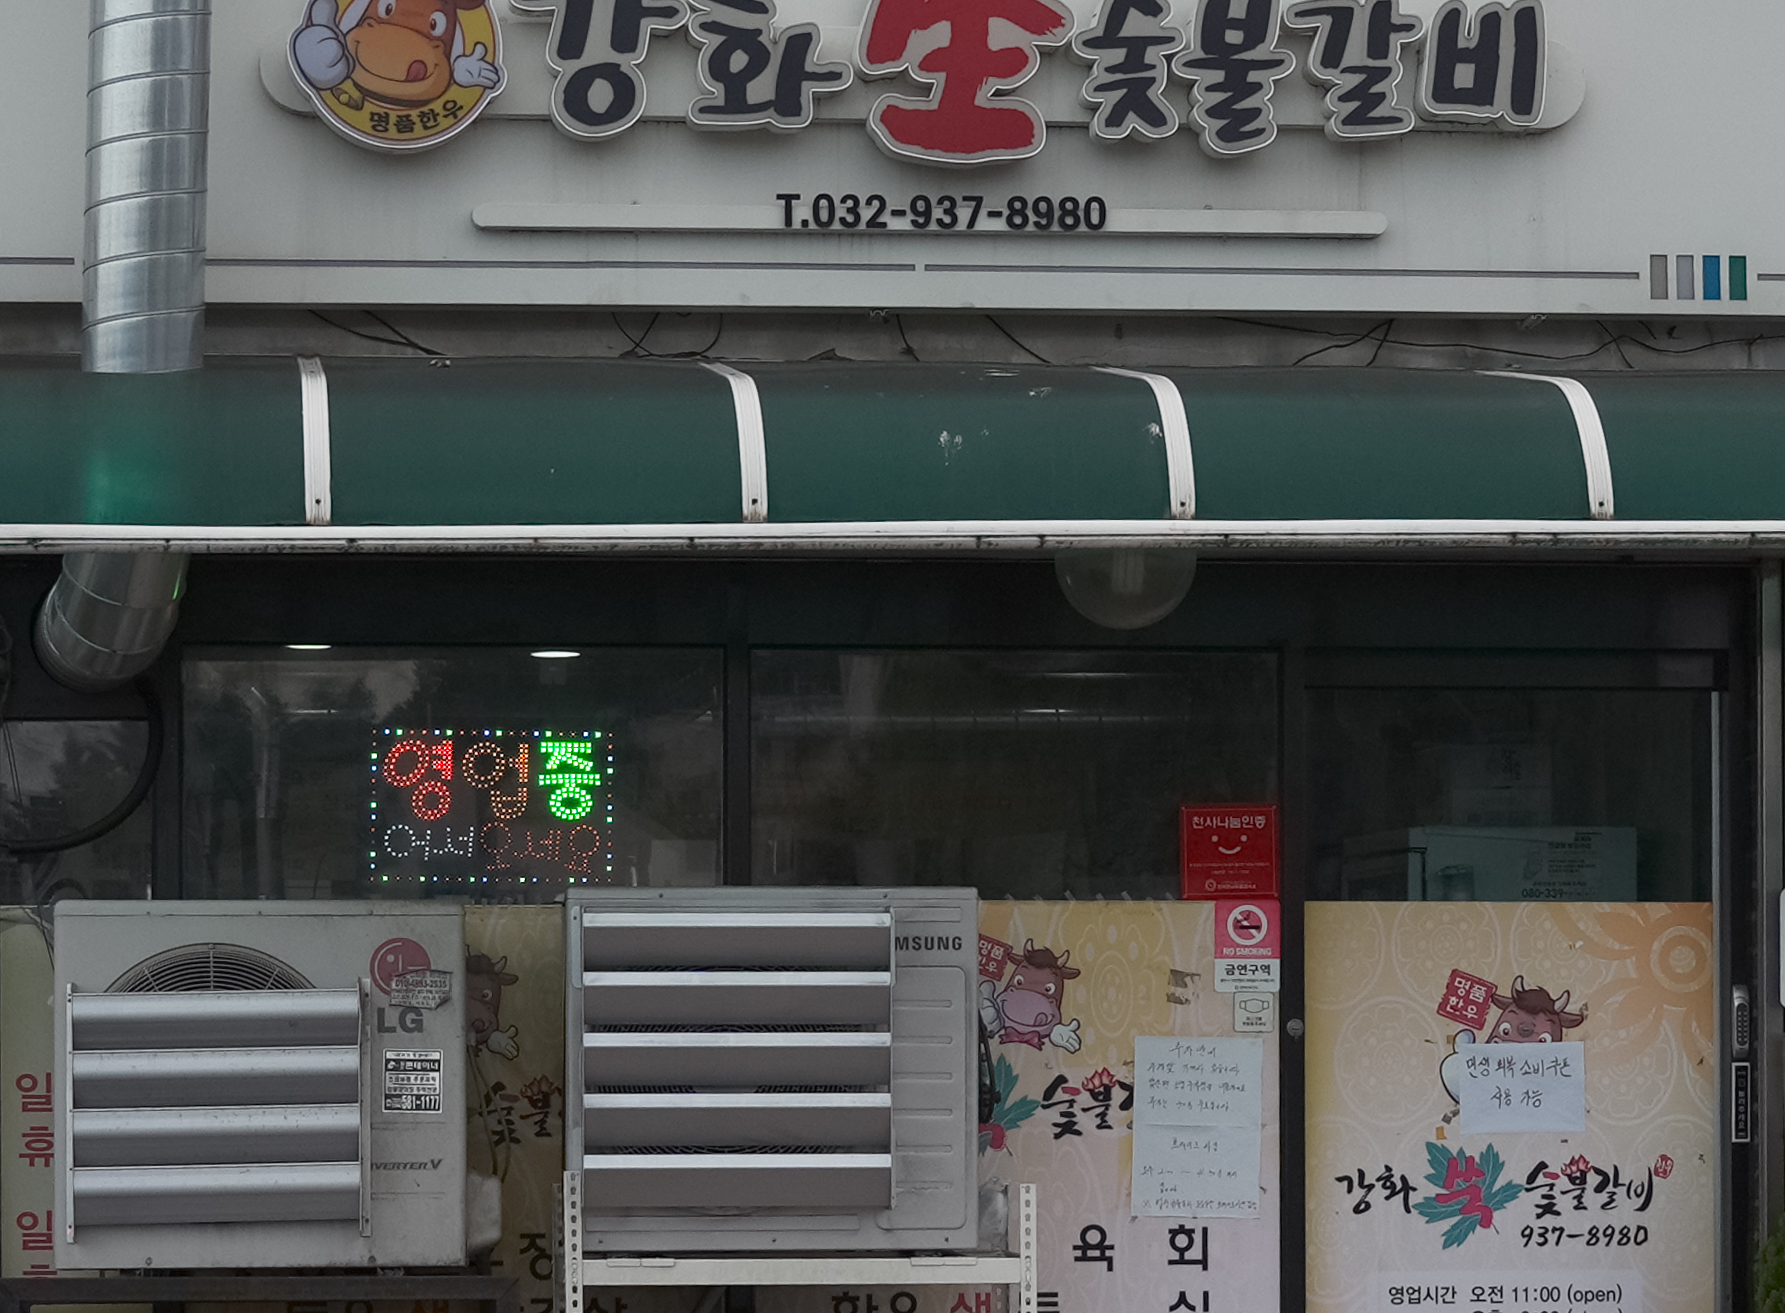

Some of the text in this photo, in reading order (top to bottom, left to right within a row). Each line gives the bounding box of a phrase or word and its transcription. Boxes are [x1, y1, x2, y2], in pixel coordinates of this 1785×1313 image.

[369, 99, 465, 134] 명품한우
[777, 192, 1107, 234] T.032-937-8980
[382, 739, 602, 821] 영업중
[1192, 815, 1267, 830] 천사나눔인증
[383, 823, 601, 874] 어서오세요
[893, 935, 963, 951] MSUNG
[1223, 947, 1272, 956] NO SMOKING
[1225, 964, 1271, 976] 금연구역
[1454, 977, 1488, 1004] 명품
[1446, 995, 1479, 1019] 한우
[377, 1007, 423, 1033] LG
[1466, 1056, 1491, 1078] 민생
[1334, 1165, 1417, 1214] 강화
[1524, 1158, 1655, 1219] 숯불갈비
[1520, 1224, 1649, 1247] 937-8980
[1388, 1284, 1623, 1305] 영업시간 오전 11:00 (open)
